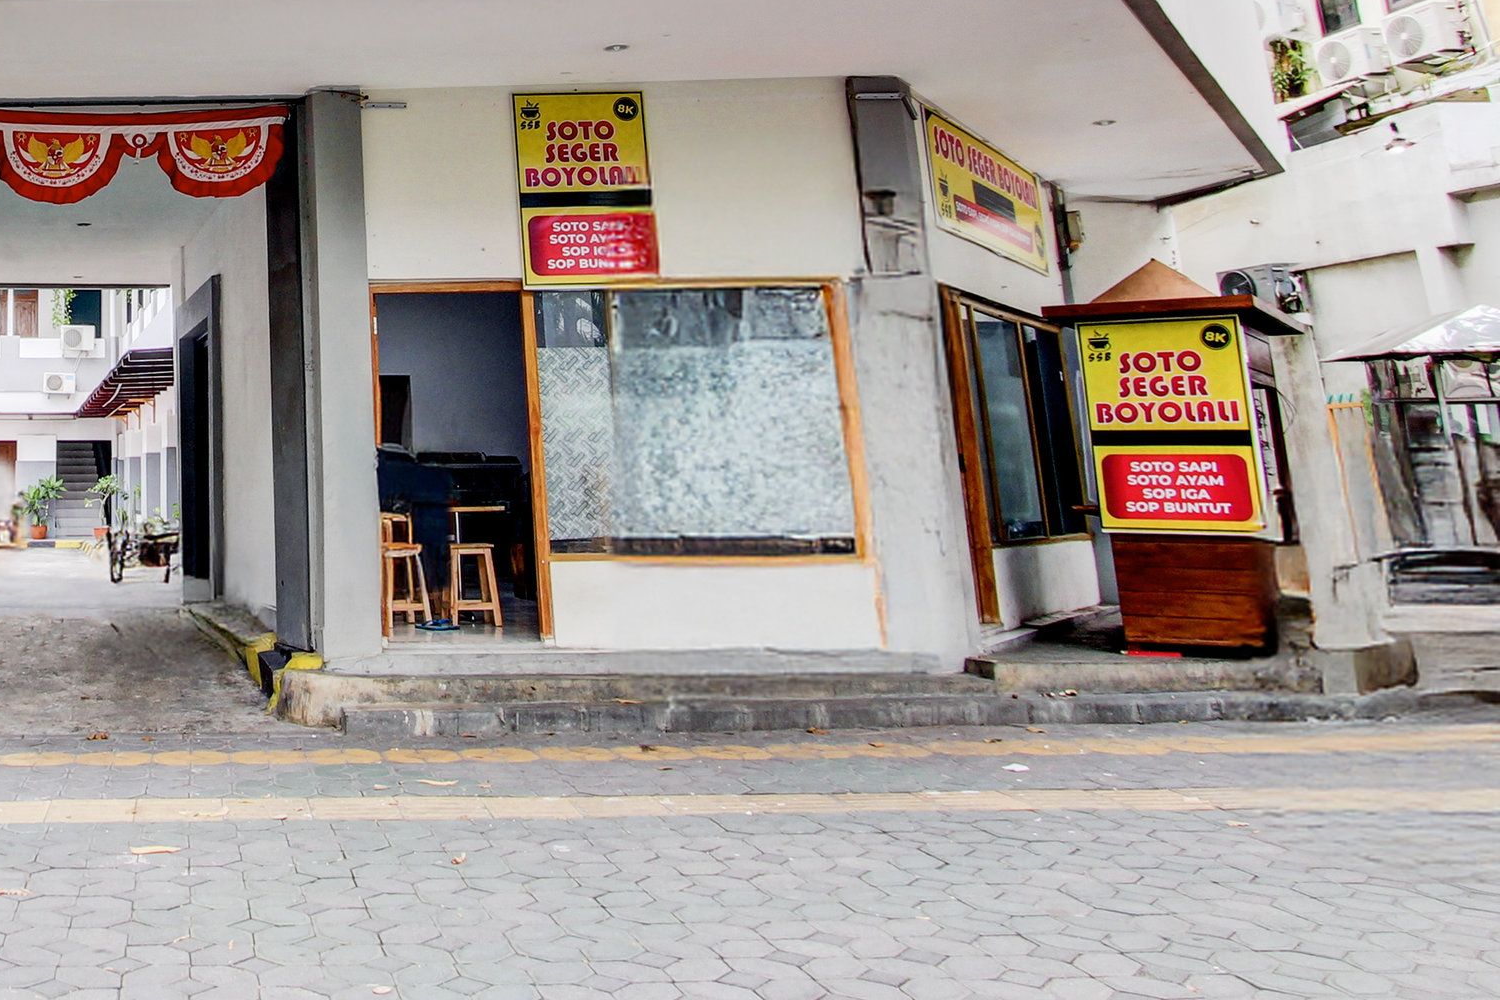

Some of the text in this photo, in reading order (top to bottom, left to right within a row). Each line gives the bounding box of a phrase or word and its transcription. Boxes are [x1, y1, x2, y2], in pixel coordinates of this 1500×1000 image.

[617, 103, 634, 116] 8K
[520, 120, 541, 130] SSB
[546, 120, 615, 142] SOTO
[545, 142, 619, 164] SEGER
[933, 125, 965, 168] SOTO
[967, 145, 998, 186] SEGER
[525, 165, 642, 188] BOYOLA
[552, 221, 590, 232] SOTO
[549, 233, 587, 245] SOTO
[561, 246, 590, 257] SOP
[547, 258, 576, 270] SOP
[1204, 331, 1228, 344] 8K
[1088, 351, 1112, 363] SSB
[1119, 350, 1202, 374] SOTO
[1119, 375, 1208, 398] SEGER
[1095, 400, 1240, 424] BOYOLALI
[1130, 461, 1218, 473] SOTO SAPI
[1127, 474, 1225, 487] SOTO AYAM
[1142, 488, 1211, 500] SOP IGA
[1125, 501, 1232, 514] SOP BUNTUT
